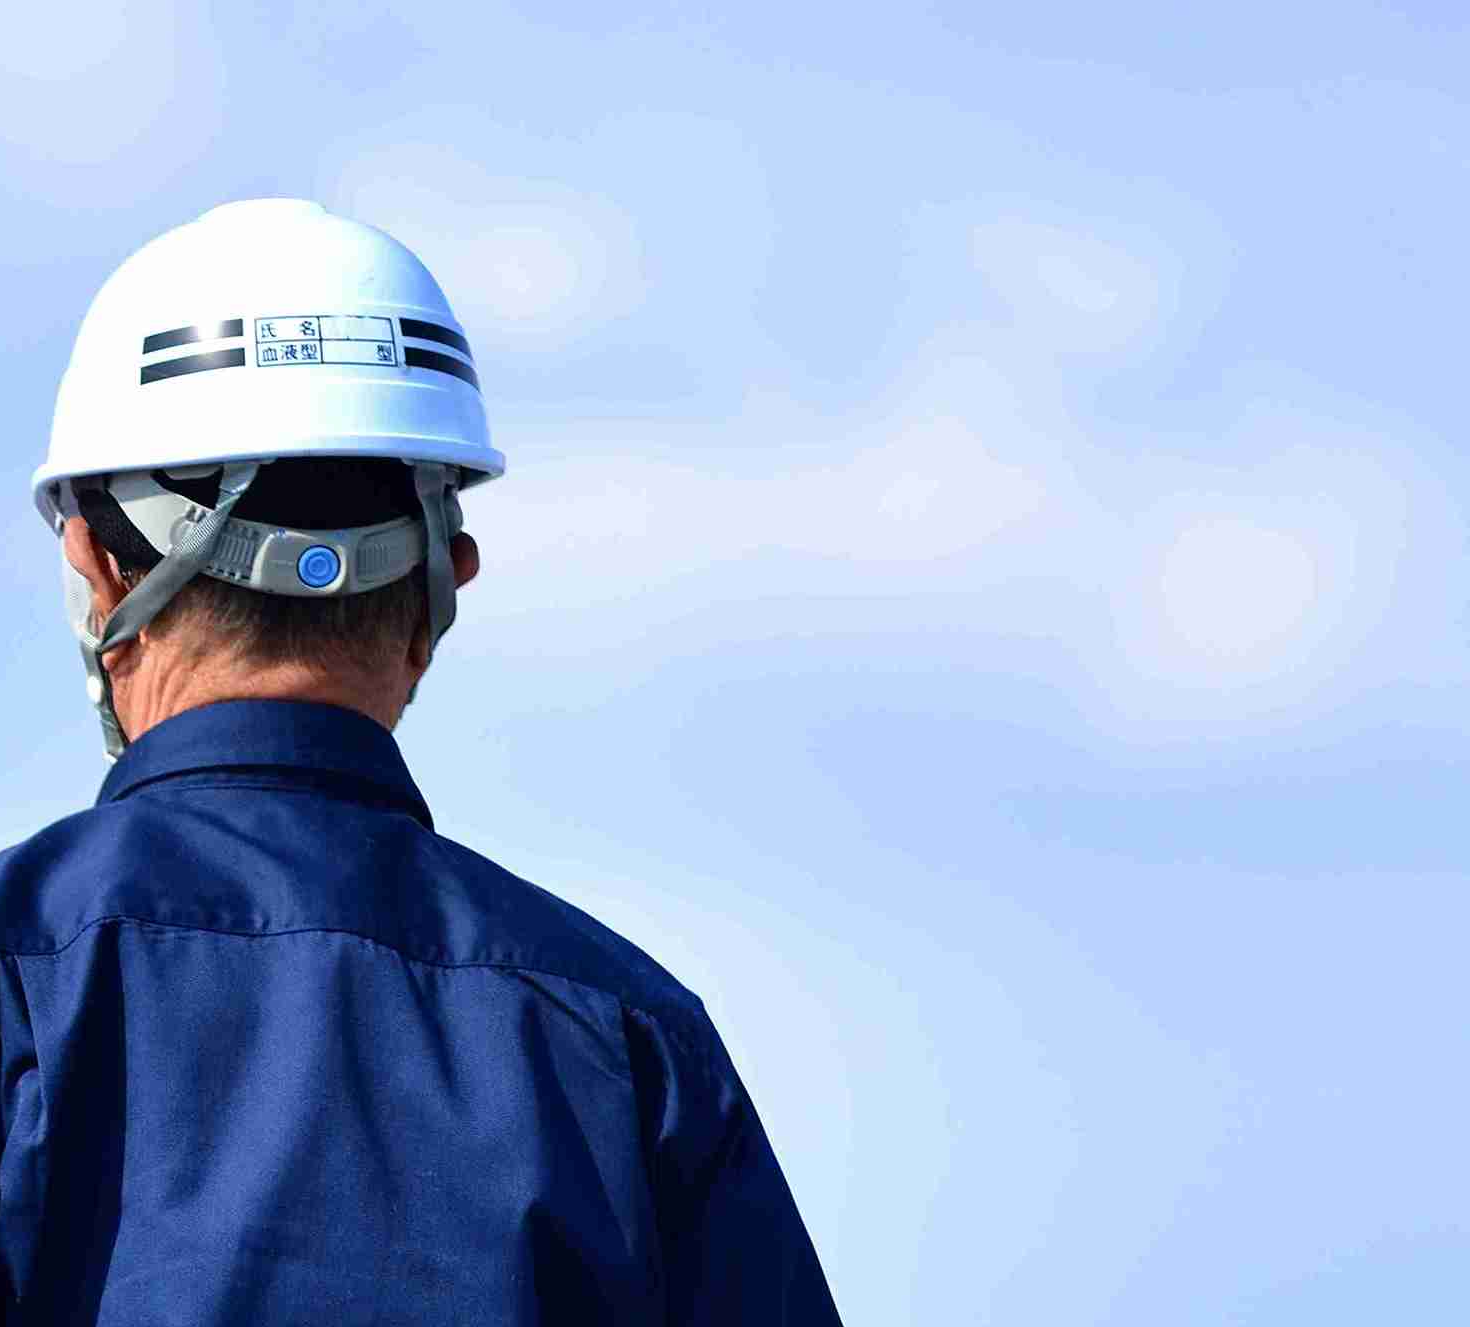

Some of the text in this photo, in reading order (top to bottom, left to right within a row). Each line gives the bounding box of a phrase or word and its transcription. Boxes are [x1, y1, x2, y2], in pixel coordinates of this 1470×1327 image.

[262, 343, 393, 362] 血液型 型
